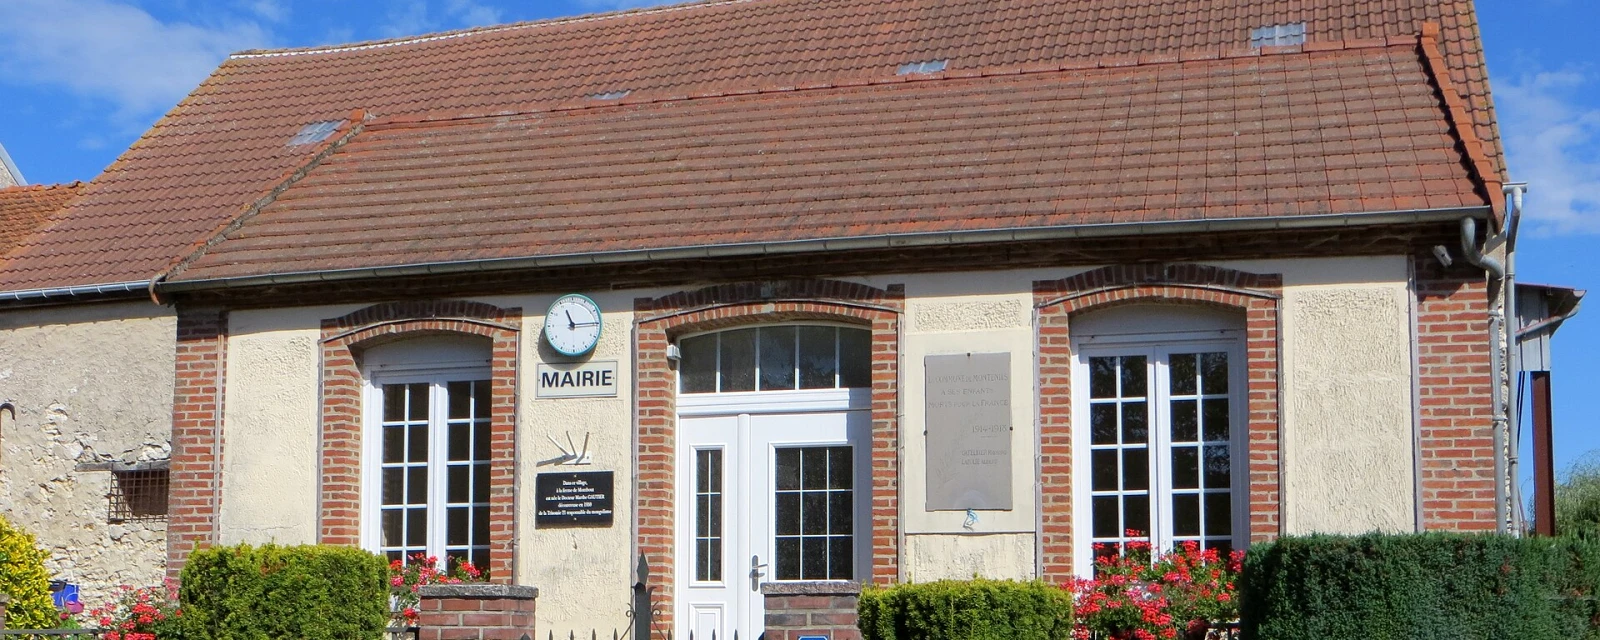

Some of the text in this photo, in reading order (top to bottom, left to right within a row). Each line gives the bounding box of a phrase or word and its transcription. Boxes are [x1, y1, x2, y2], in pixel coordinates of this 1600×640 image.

[542, 370, 612, 388] MAIRIE
[935, 374, 964, 383] COMMUNE
[980, 399, 1009, 407] FRANCE
[972, 424, 1007, 433] 1914-1918
